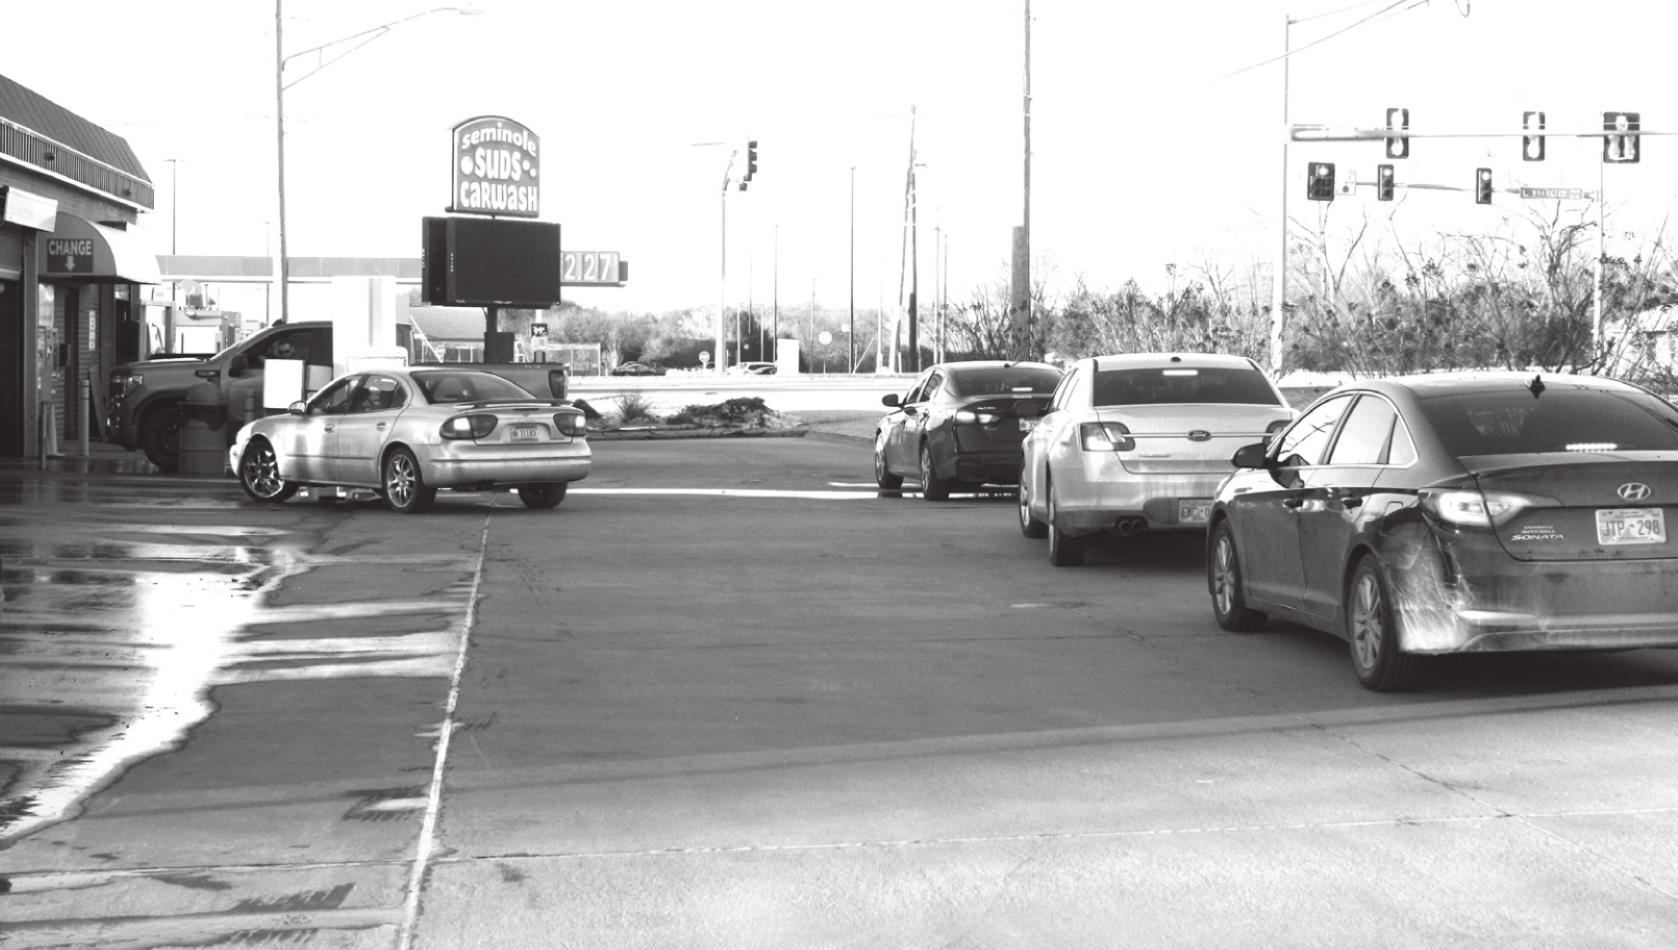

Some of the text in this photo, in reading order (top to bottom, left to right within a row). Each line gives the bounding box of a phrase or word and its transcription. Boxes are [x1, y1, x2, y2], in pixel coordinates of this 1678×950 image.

[461, 122, 537, 158] seminole
[474, 146, 522, 182] SUDS
[48, 239, 92, 256] CHANGE
[564, 254, 613, 281] 2.27
